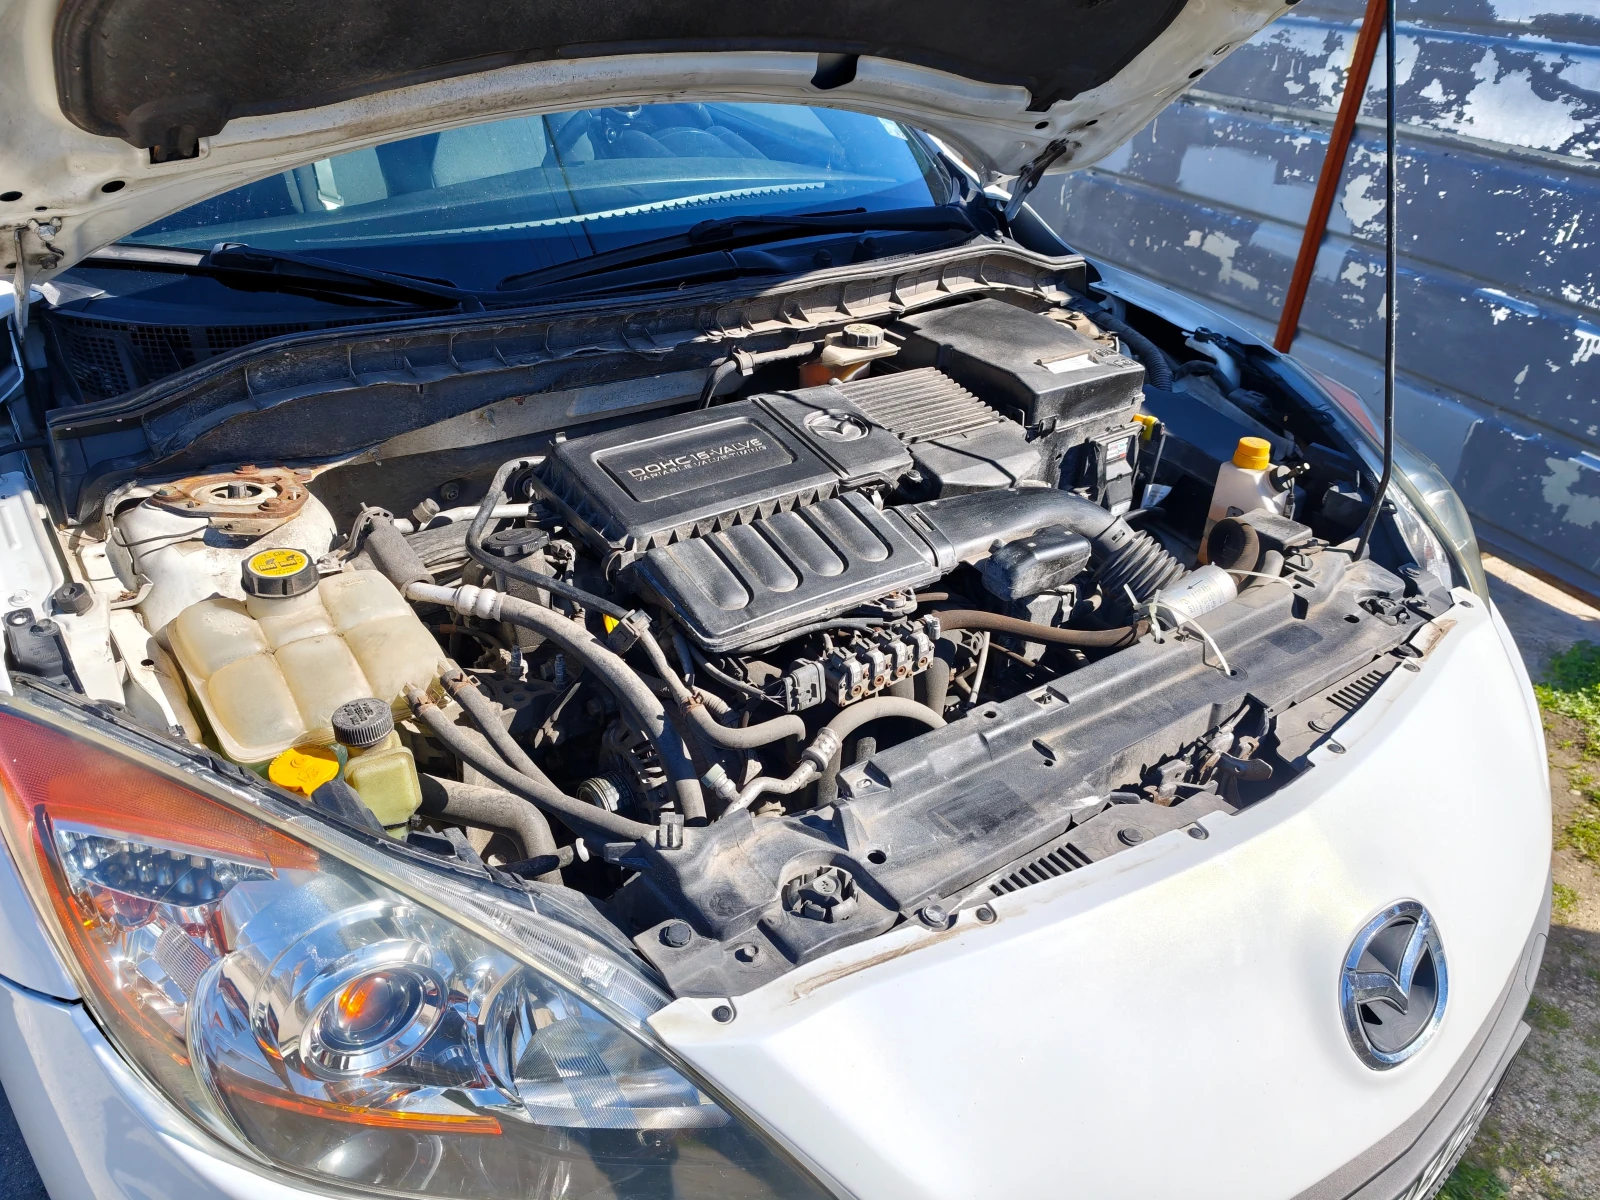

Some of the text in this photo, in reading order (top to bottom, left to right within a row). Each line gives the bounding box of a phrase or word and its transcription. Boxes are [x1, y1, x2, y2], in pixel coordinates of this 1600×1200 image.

[627, 456, 691, 478] DOHC
[635, 445, 767, 481] VARIABLE VALVE TIMING
